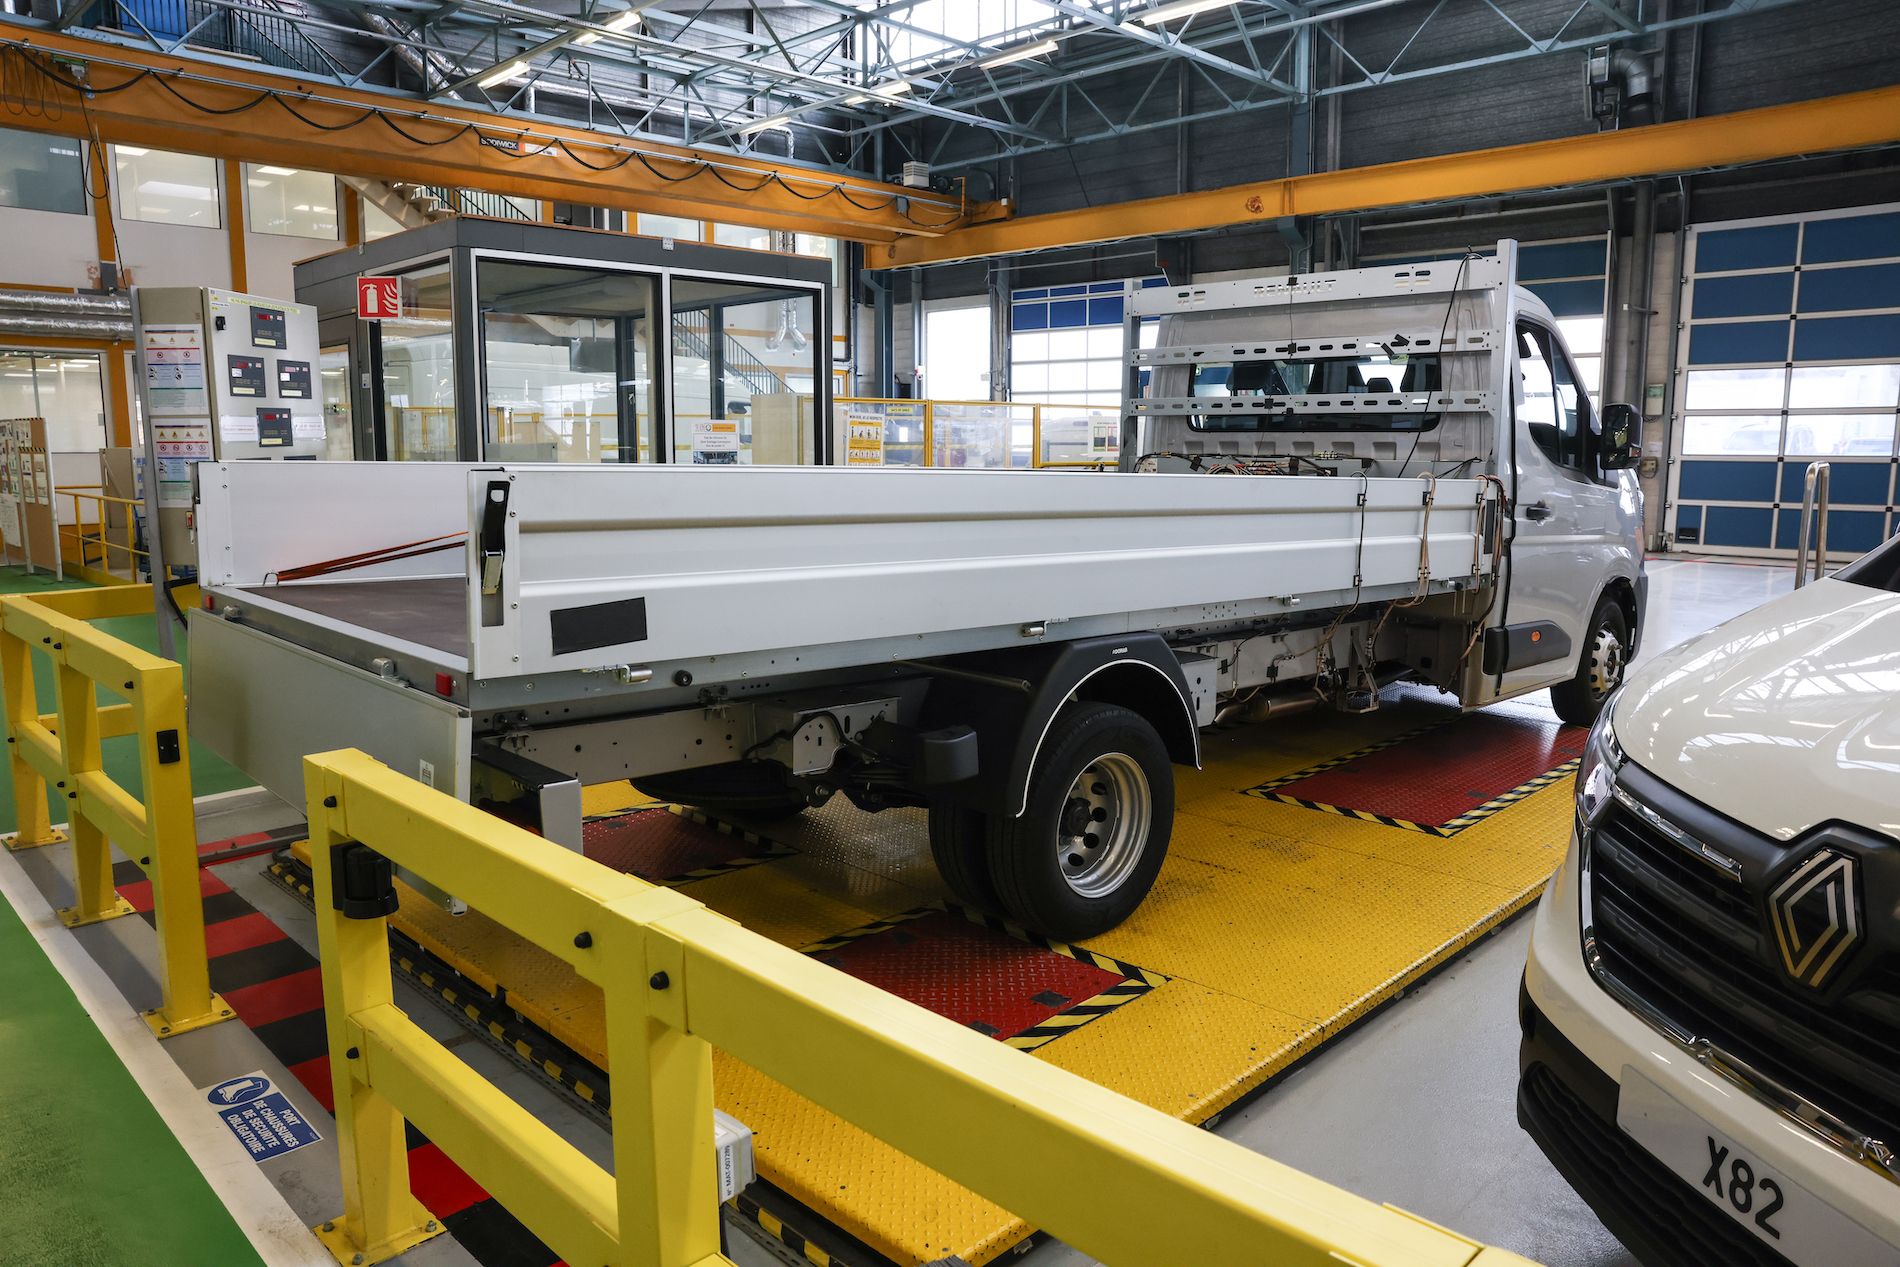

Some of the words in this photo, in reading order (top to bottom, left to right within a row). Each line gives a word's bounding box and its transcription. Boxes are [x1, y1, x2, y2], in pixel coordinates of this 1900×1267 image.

[1254, 280, 1336, 297] RENAULT
[242, 1108, 257, 1120] DE
[252, 1099, 268, 1110] DE
[260, 1107, 299, 1148] CHAUSSURES
[280, 1108, 301, 1126] PORT
[227, 1113, 266, 1154] OBLIGATOIRE
[249, 1117, 280, 1148] SECURITE
[1702, 1135, 1784, 1240] X82
